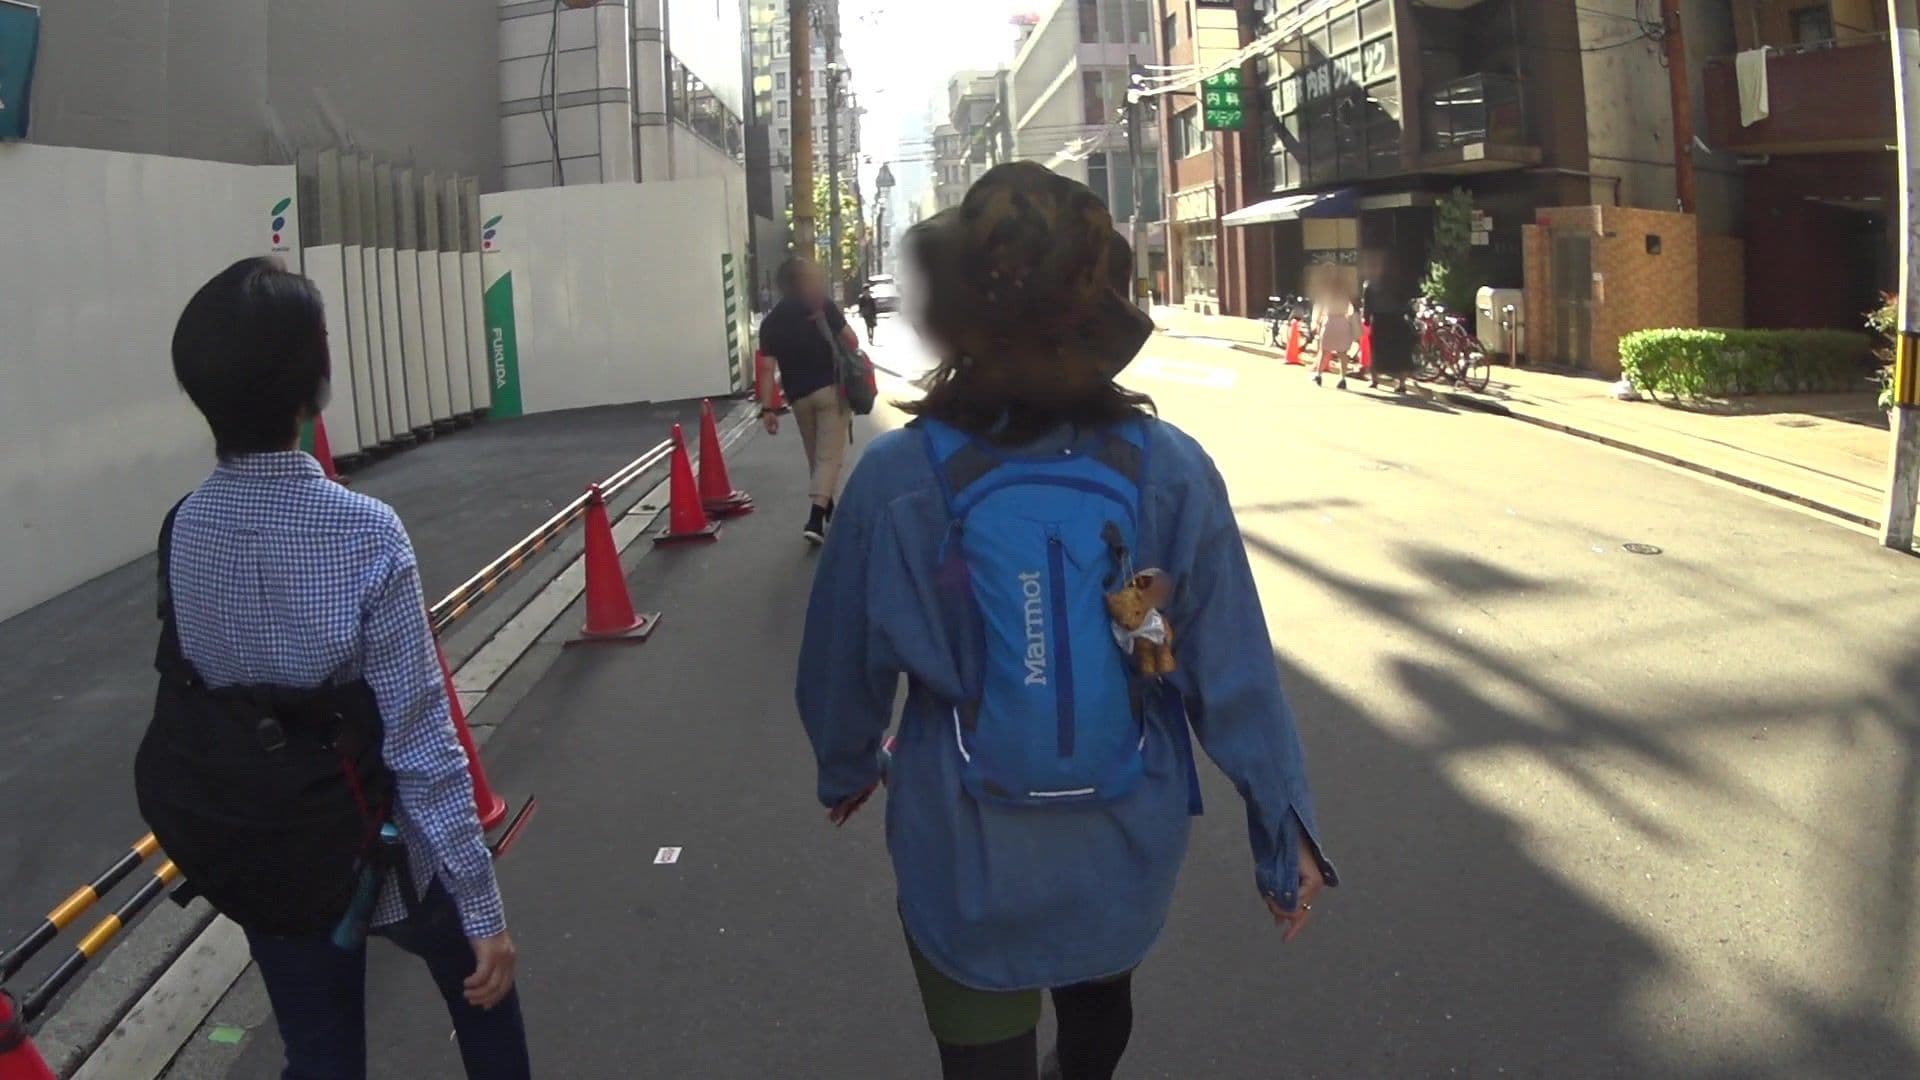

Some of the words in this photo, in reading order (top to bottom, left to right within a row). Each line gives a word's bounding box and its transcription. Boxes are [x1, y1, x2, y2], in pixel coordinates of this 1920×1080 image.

[1206, 92, 1239, 106] 内科
[1207, 110, 1241, 120] クリニック
[492, 327, 506, 389] FUKUDA
[1018, 570, 1046, 686] Marmot
